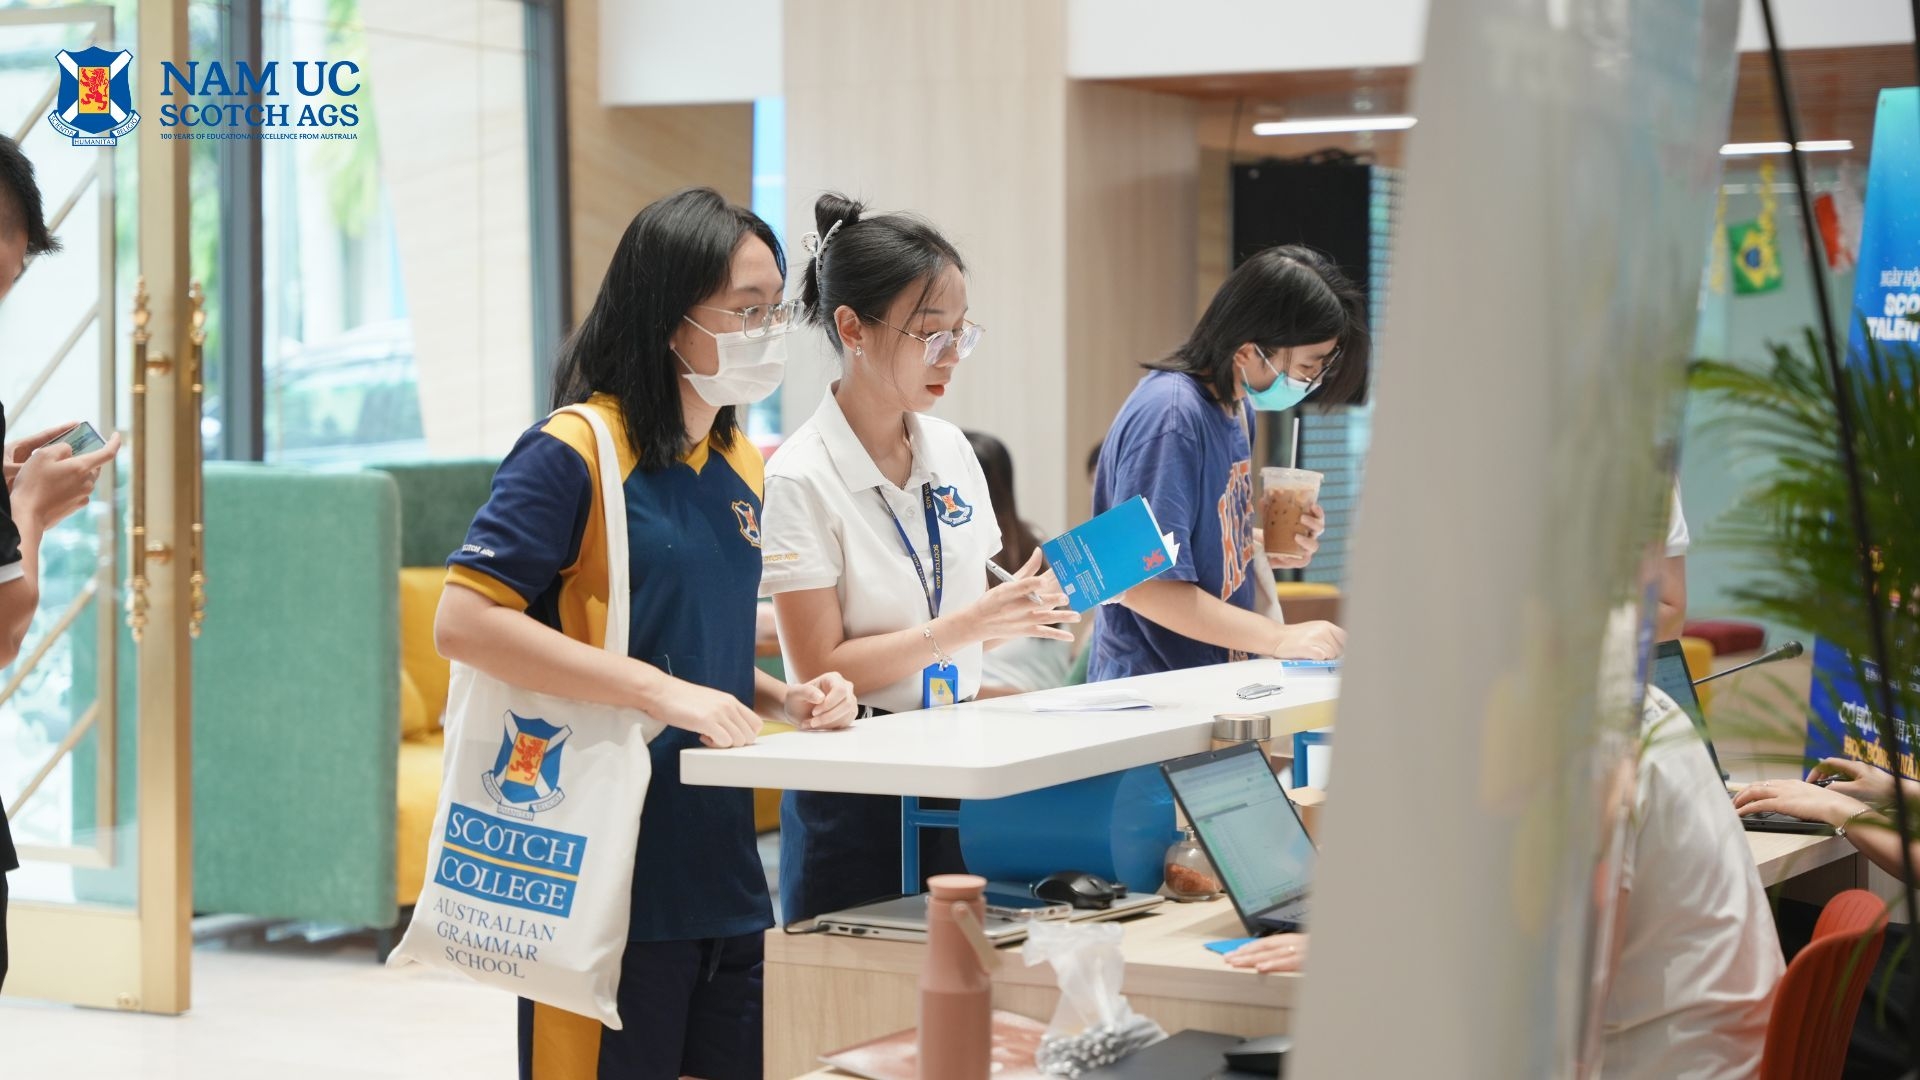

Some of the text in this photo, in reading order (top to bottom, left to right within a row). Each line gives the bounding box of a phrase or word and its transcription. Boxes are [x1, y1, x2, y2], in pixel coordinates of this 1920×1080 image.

[932, 544, 941, 573] SCOTCH
[448, 811, 577, 868] SCOTCH
[441, 856, 567, 910] COLLEGE
[433, 896, 557, 943] AUSTRALIAN
[436, 920, 539, 963] GRAMMAR
[445, 945, 526, 979] SCHOOL
